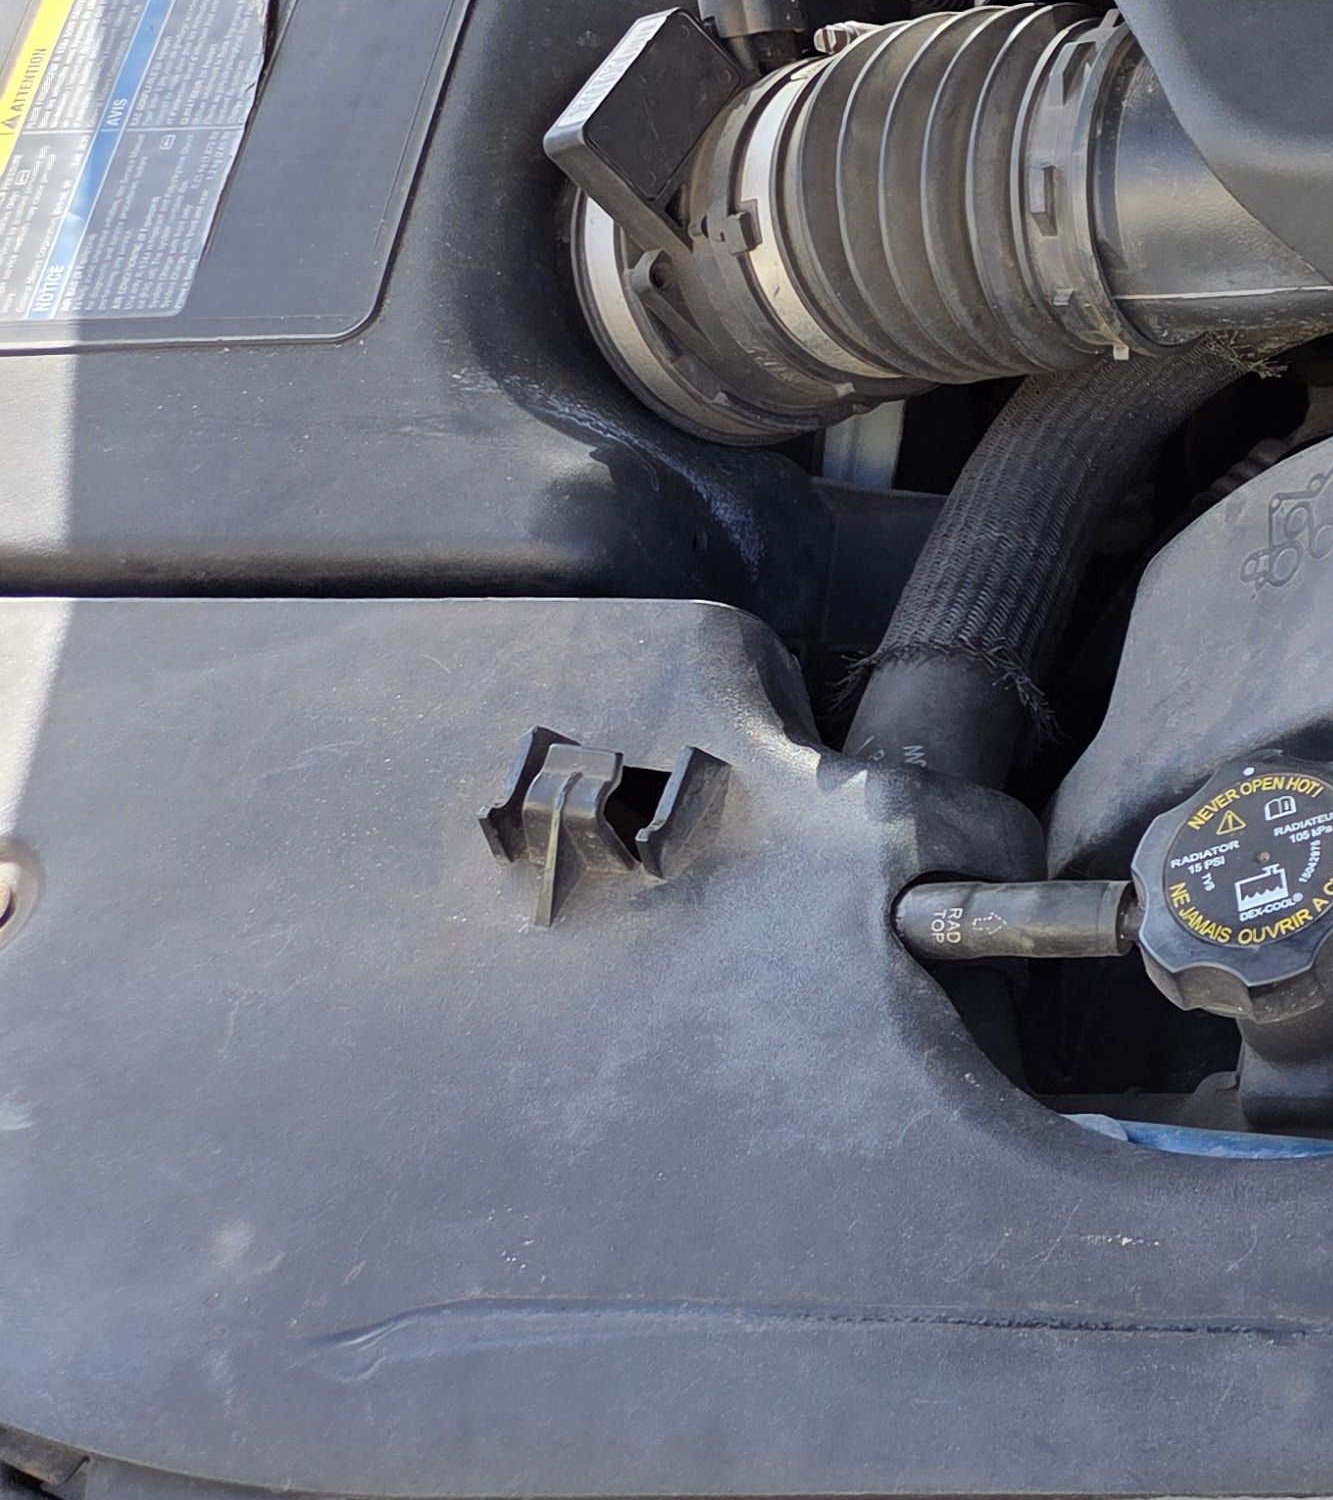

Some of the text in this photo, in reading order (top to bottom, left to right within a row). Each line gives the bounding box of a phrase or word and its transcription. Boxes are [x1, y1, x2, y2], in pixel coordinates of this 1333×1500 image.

[11, 48, 47, 112] ATTENTION
[105, 98, 127, 127] AVIS
[36, 265, 64, 313] NOTICE
[1187, 776, 1323, 829] NEVER OPEN HOT!
[1289, 825, 1333, 842] 105 kPa
[1170, 840, 1240, 868] RADIATOR
[1188, 856, 1224, 873] 15 PSI
[1169, 882, 1191, 908] NE
[931, 910, 946, 943] TOP
[947, 908, 963, 943] RAD
[1178, 905, 1232, 943] JAMAIS
[1237, 908, 1313, 944] OUVRIR
